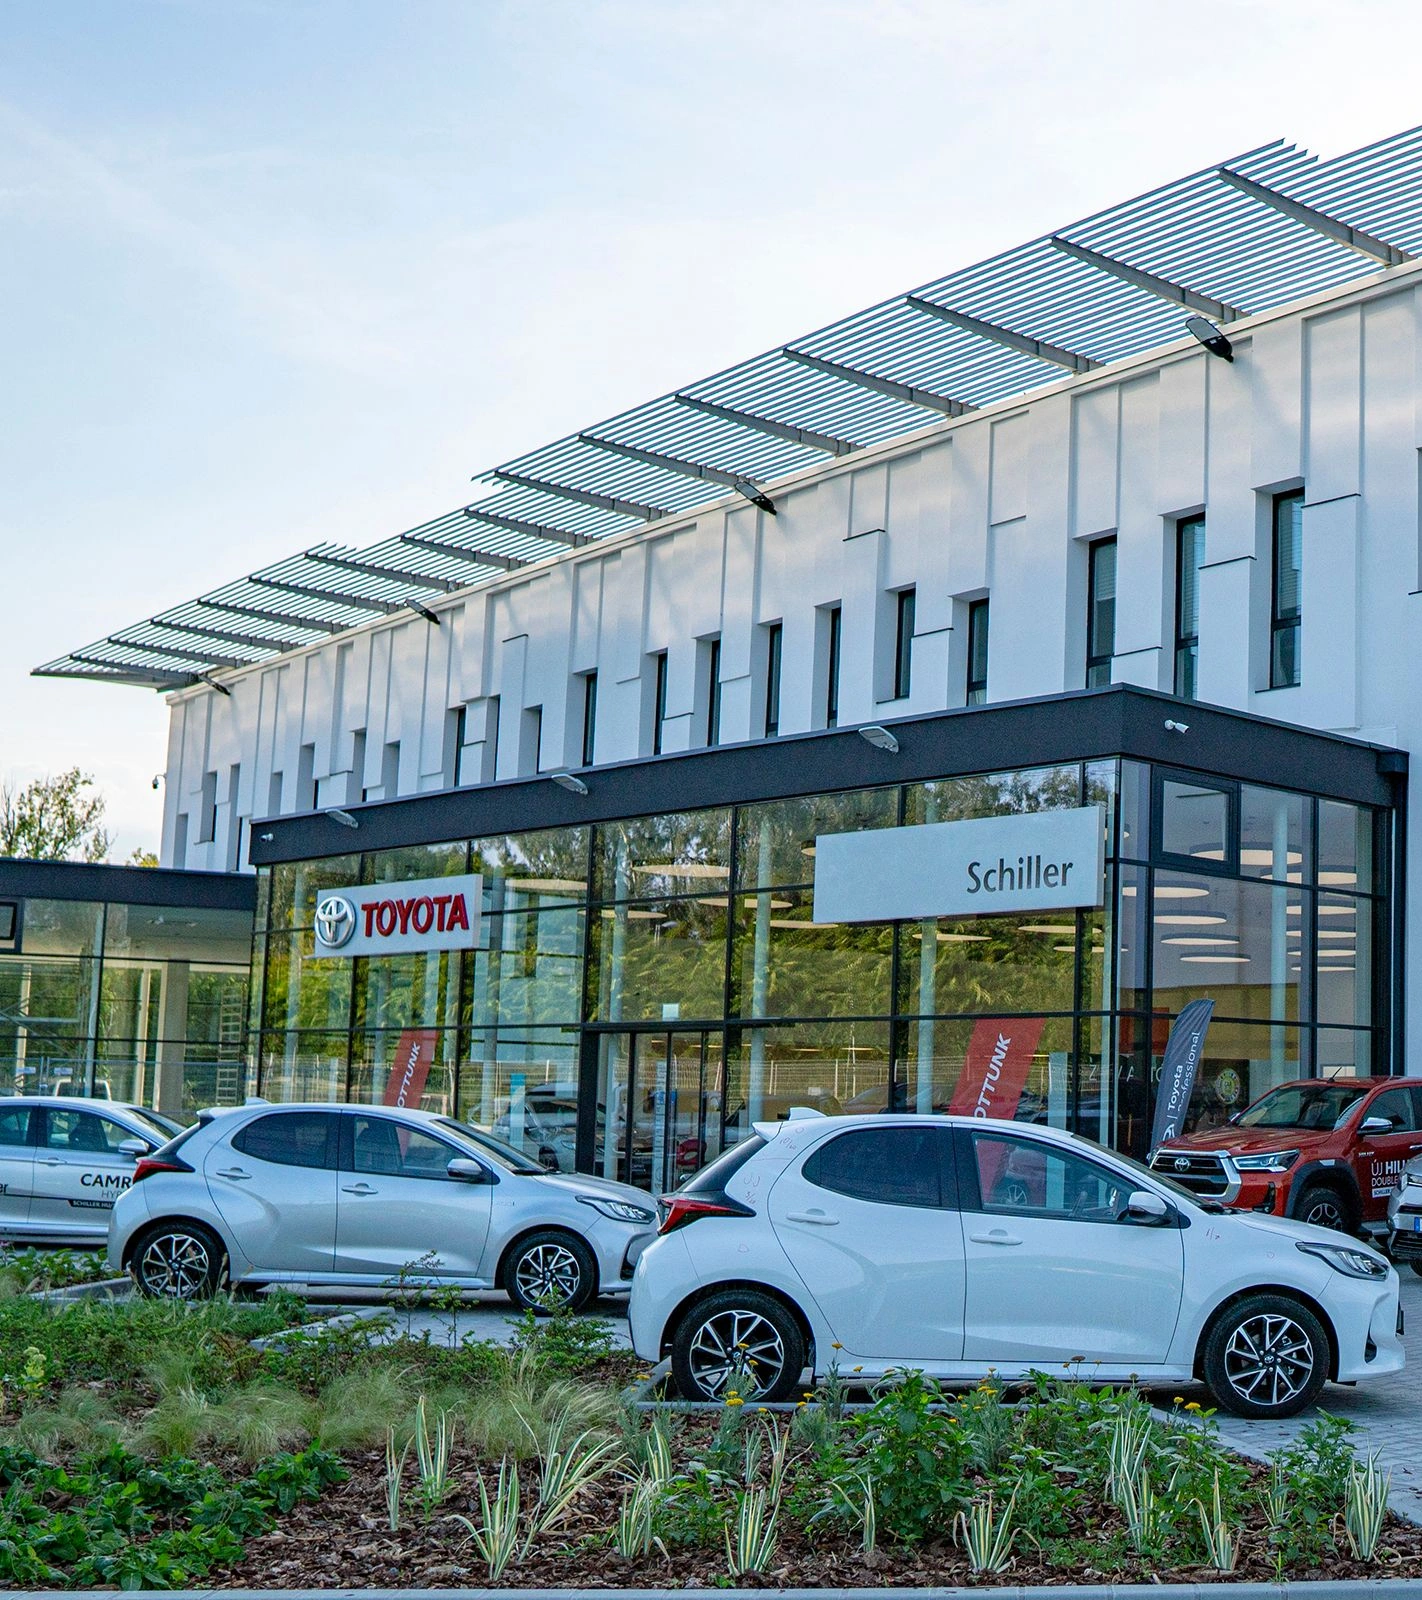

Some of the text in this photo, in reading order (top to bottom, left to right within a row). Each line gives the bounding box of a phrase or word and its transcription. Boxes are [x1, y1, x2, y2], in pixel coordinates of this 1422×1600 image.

[966, 855, 1074, 894] Schiller
[361, 893, 470, 937] TOYOTA
[1167, 1065, 1183, 1111] Toyota
[80, 1173, 132, 1189] CAMR
[1371, 1159, 1383, 1176] ÚJ
[1371, 1175, 1399, 1187] DOUBLE
